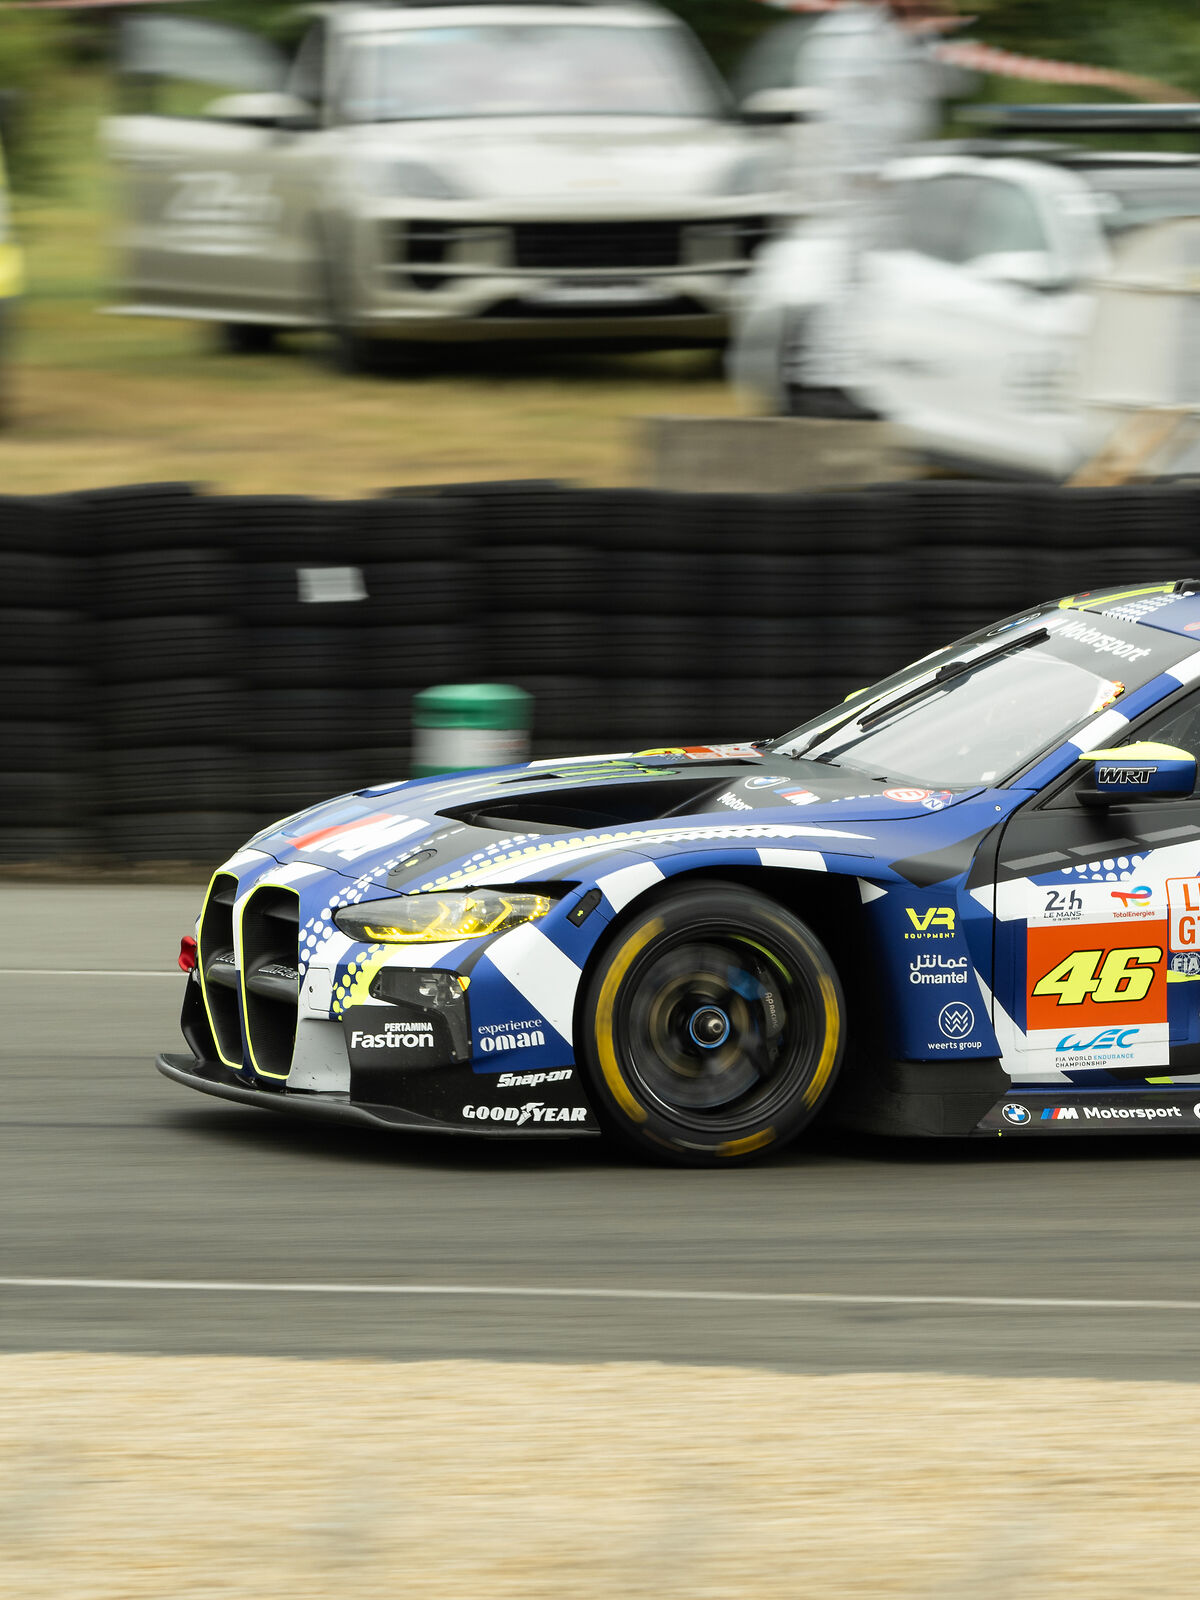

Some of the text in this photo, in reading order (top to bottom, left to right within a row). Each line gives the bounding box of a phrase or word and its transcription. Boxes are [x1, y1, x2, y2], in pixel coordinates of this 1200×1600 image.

[1053, 619, 1152, 662] Motorsport
[1098, 766, 1158, 784] WRT
[1045, 890, 1083, 911] 24h
[905, 907, 956, 931] VR
[1113, 910, 1156, 919] TotalEnergies
[909, 954, 968, 972] عمانتل
[1173, 957, 1200, 972] FIA
[909, 971, 968, 984] Omantel
[1031, 945, 1164, 1007] 46
[384, 1022, 434, 1032] PERTAMINA
[478, 1018, 543, 1036] experience
[350, 1031, 435, 1049] Fastron
[479, 1030, 546, 1052] oman
[927, 1041, 983, 1051] weerts group
[1056, 1028, 1140, 1052] WEC
[1055, 1060, 1108, 1068] CHAMPIONSHIP
[1093, 1053, 1135, 1061] ENDURANCE
[496, 1069, 573, 1088] Snap-on
[1083, 1106, 1183, 1120] Motorsport
